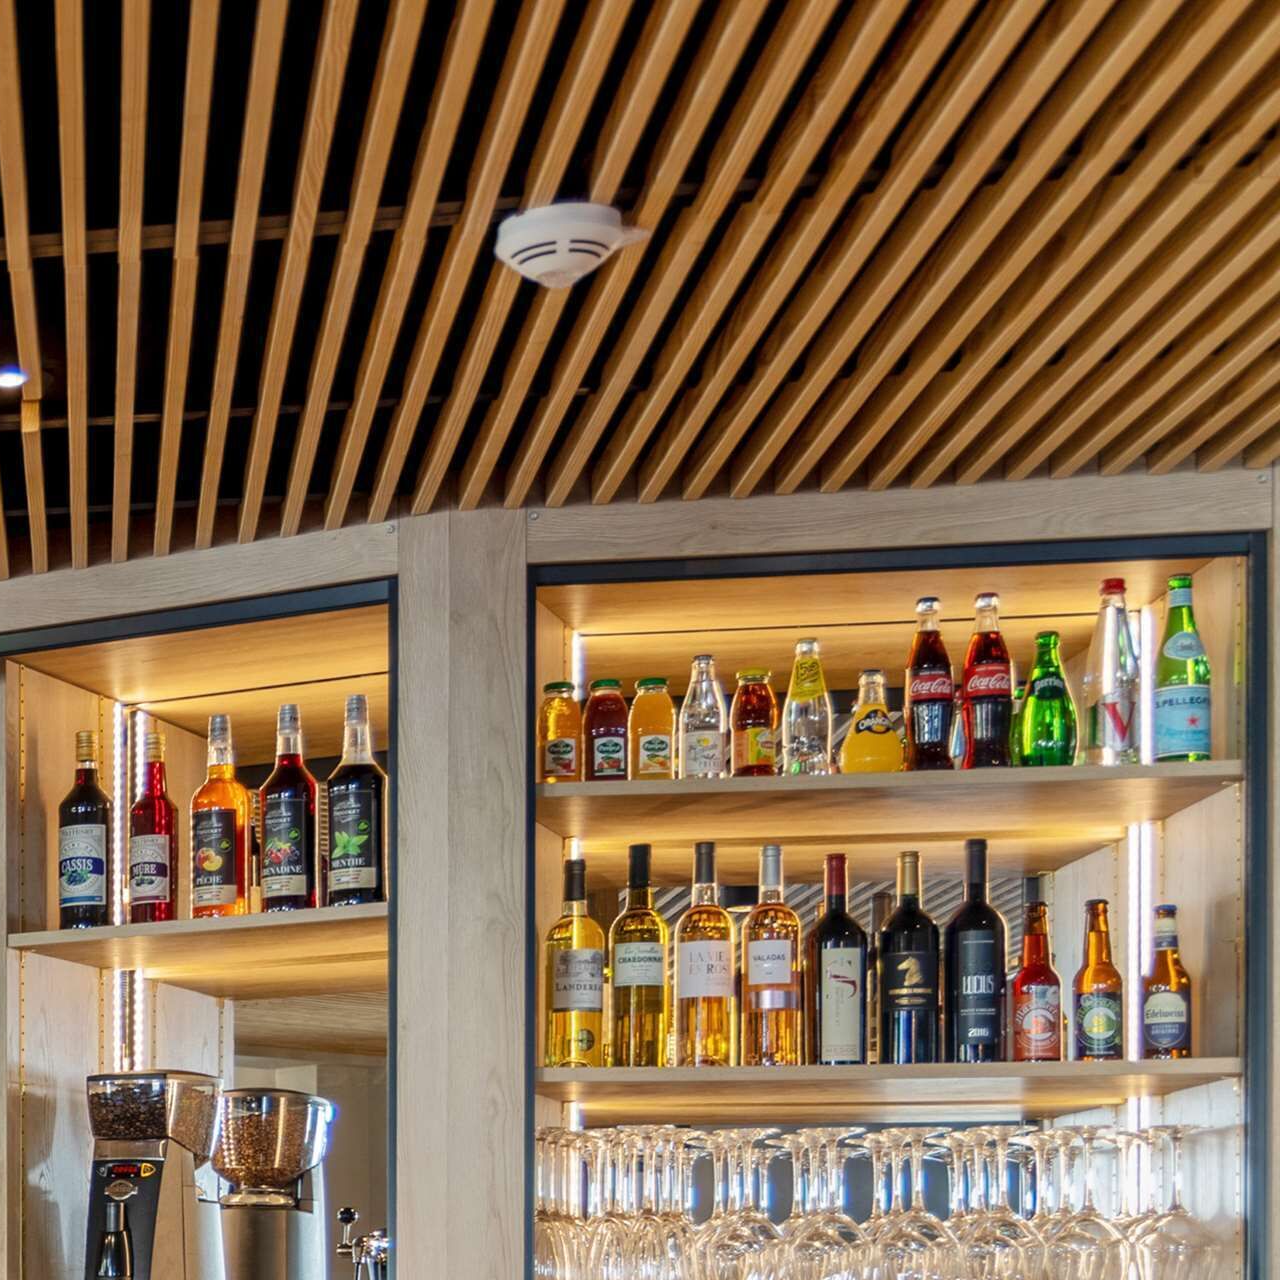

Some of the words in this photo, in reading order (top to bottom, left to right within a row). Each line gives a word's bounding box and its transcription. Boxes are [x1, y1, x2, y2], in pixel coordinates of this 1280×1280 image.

[62, 859, 93, 872] CASSIS
[331, 857, 366, 868] MENTHE
[752, 953, 787, 962] VALADAS
